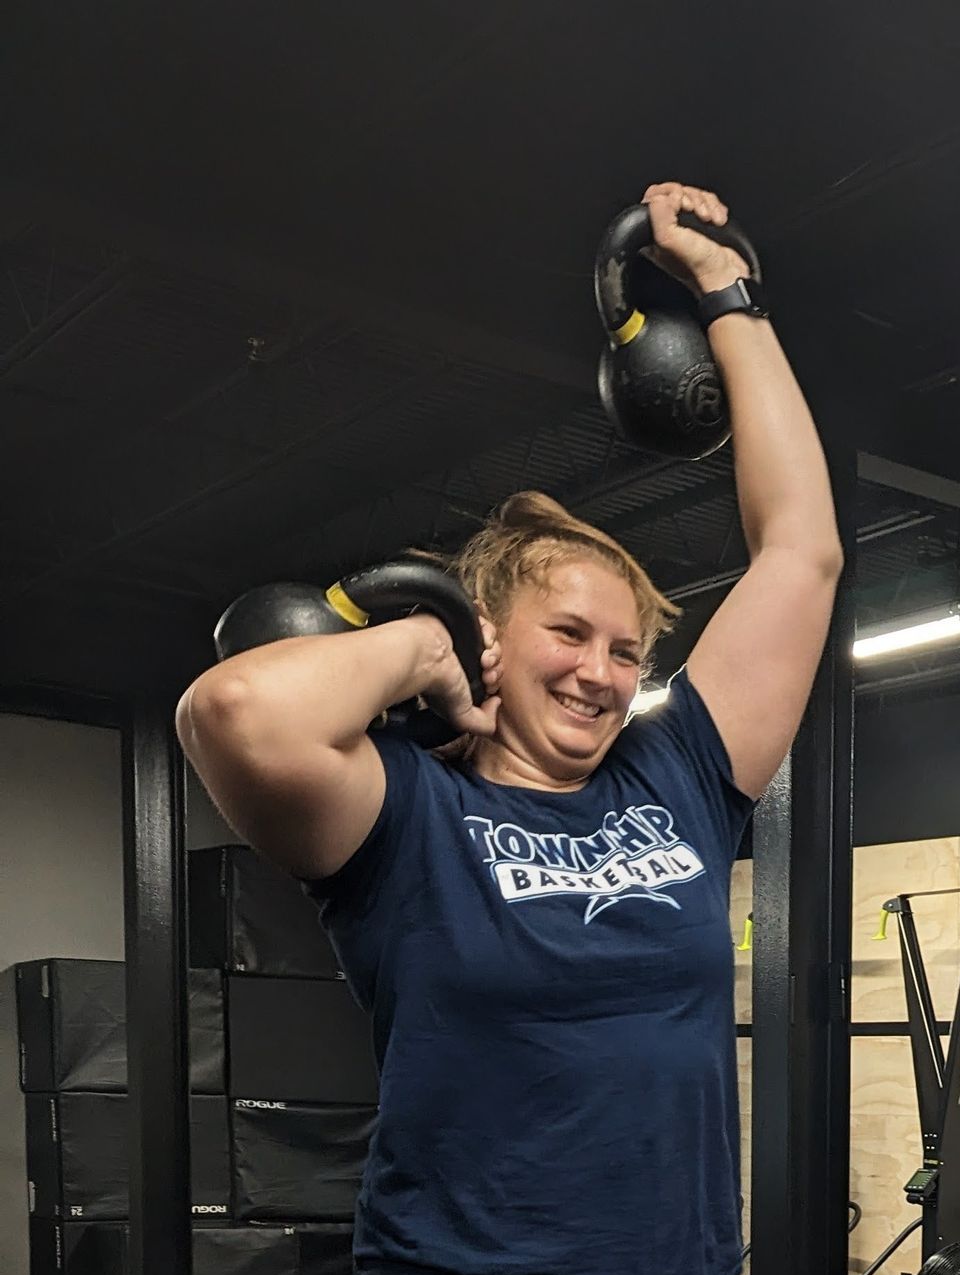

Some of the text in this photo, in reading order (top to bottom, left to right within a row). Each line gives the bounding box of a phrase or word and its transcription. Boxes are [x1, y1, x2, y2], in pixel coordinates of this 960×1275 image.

[463, 804, 680, 871] TOWNHP
[235, 1099, 287, 1110] ROGUE
[191, 1205, 227, 1214] ROGU
